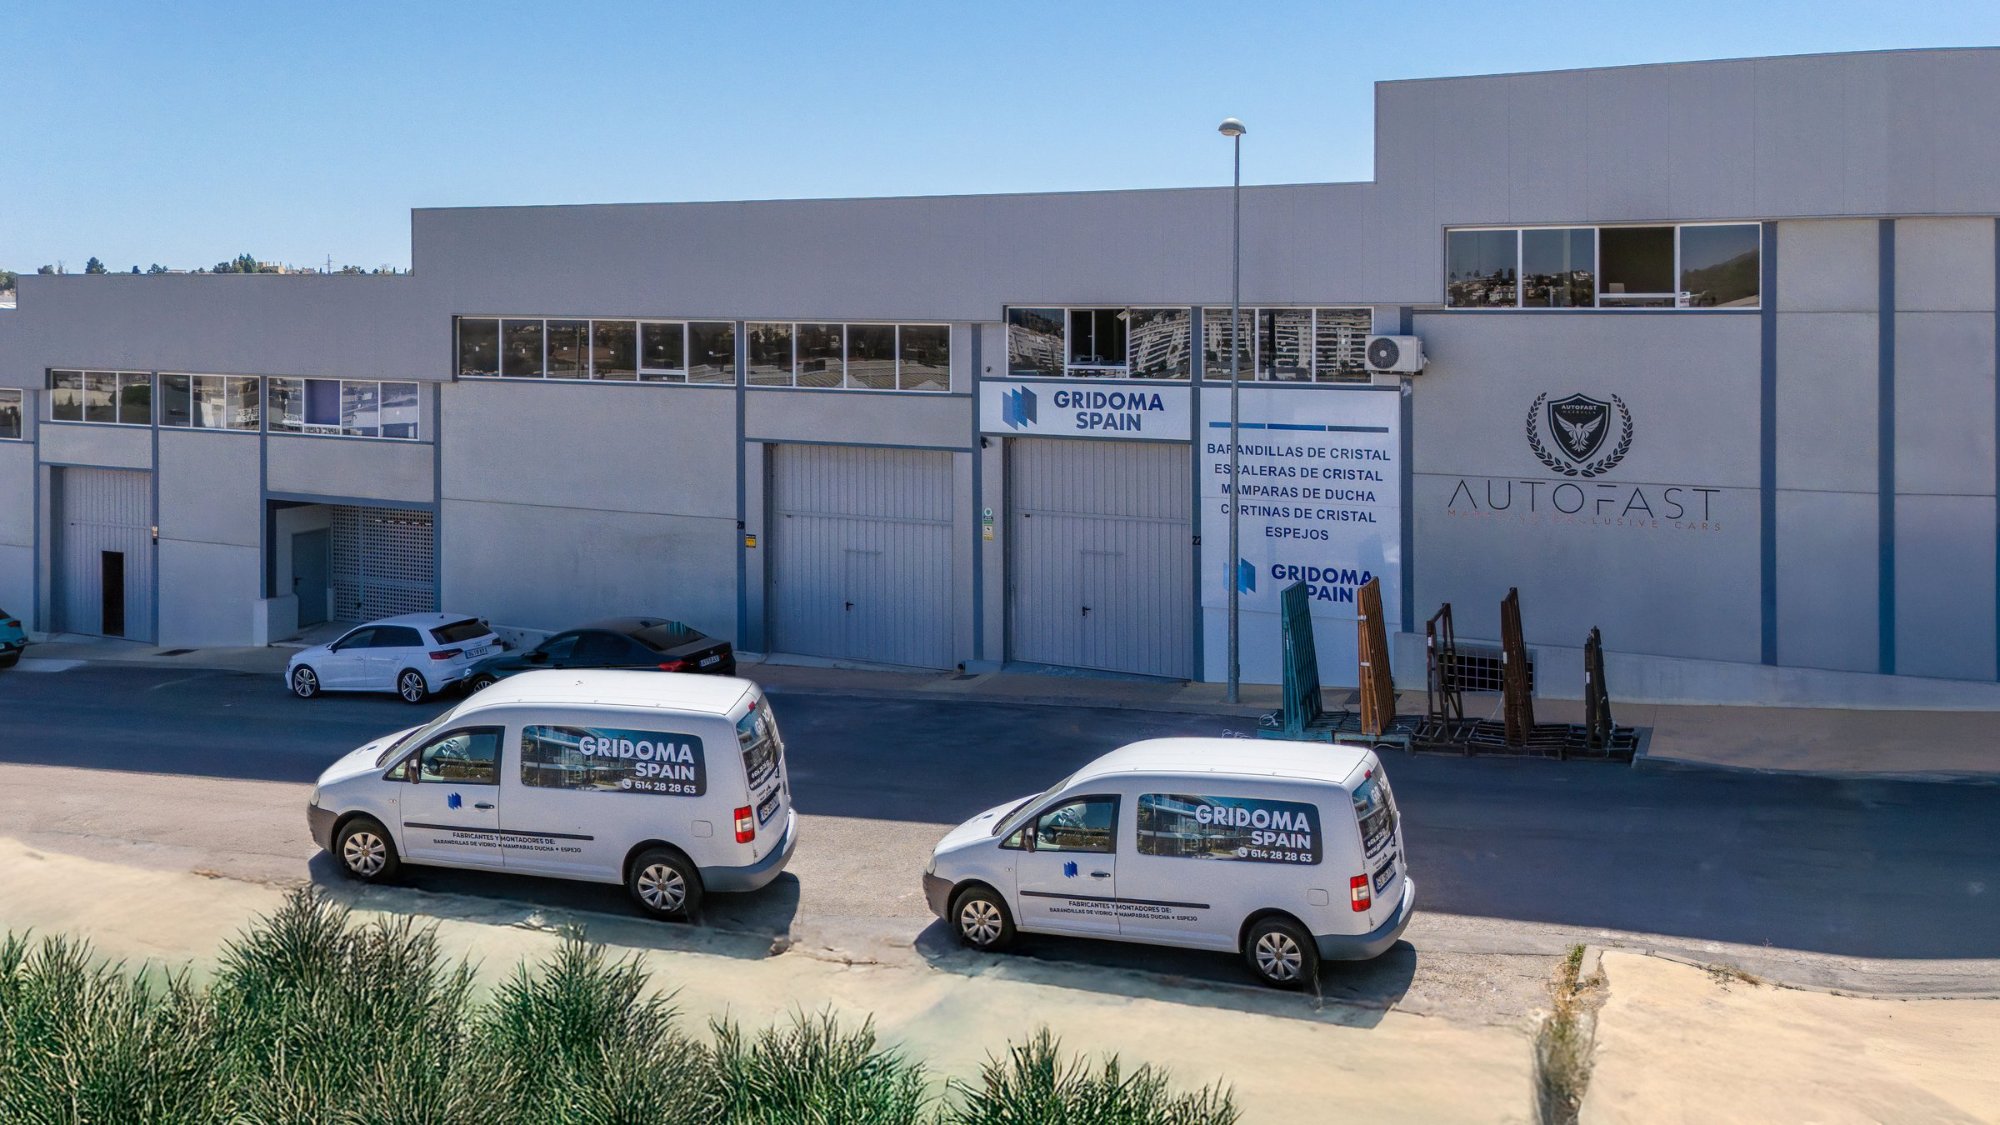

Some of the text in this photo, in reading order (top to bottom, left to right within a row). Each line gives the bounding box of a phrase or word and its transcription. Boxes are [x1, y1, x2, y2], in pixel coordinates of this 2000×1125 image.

[1053, 390, 1164, 411] GRIDOMA
[1075, 411, 1141, 432] SPAIN
[1307, 447, 1326, 459] DE
[1330, 448, 1391, 461] CRISTAL
[1214, 463, 1383, 482] ESALERAS DE CRISTAL
[1302, 487, 1320, 499] DE
[1325, 488, 1376, 502] DUCHA
[1448, 479, 1721, 521] AUTOFAST
[1220, 503, 1377, 523] CRTINAS DE CRISTAL
[1265, 526, 1329, 541] ESPEJOS
[1674, 521, 1720, 532] CARS
[1271, 563, 1372, 586] GRIDOMA
[1306, 584, 1353, 603] PAIN
[579, 736, 695, 764] GRIDOMA
[635, 762, 695, 781] SPAIN
[634, 781, 696, 794] 614 28 28 63
[1195, 804, 1311, 832] GRIDOMA
[452, 832, 494, 841] FABRICANTES
[500, 835, 544, 845] MONTADORES
[1251, 830, 1311, 850] SPAIN
[1250, 849, 1312, 862] 614 28 28 63
[1068, 900, 1110, 910] FABRICANTES
[1116, 904, 1160, 913] MONTADORES
